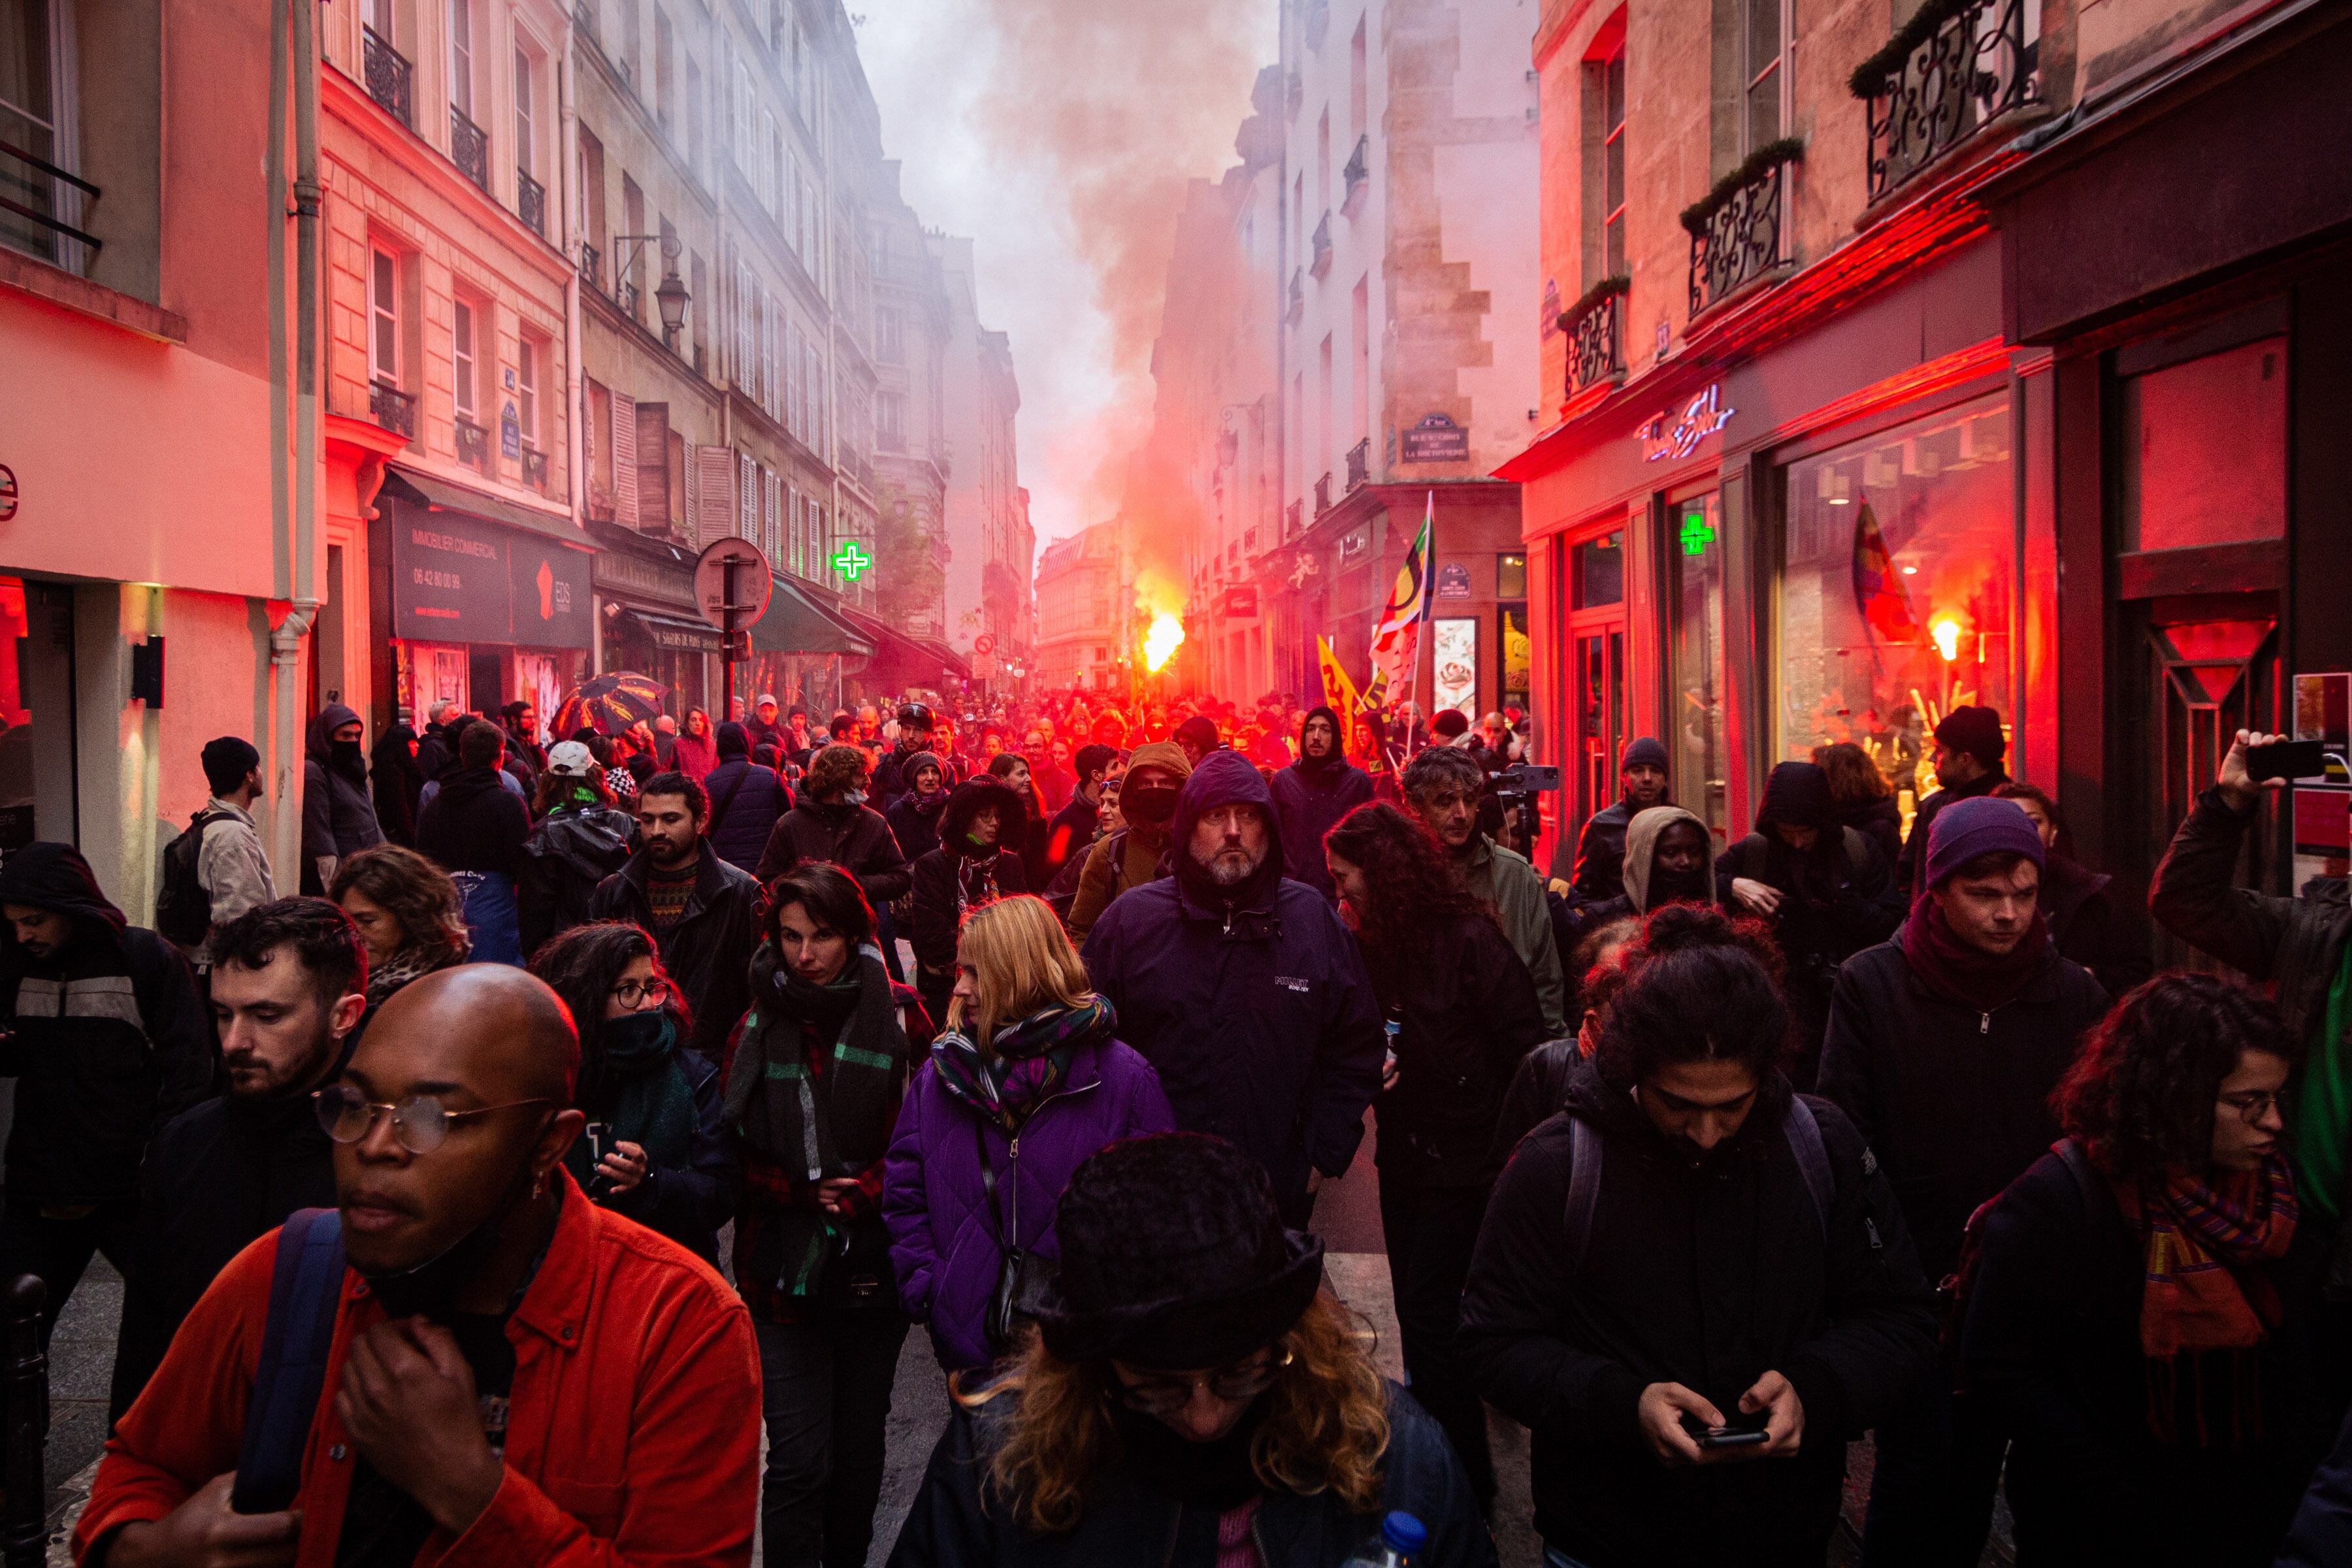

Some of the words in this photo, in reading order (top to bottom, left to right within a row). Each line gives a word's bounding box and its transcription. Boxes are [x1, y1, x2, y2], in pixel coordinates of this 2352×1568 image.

[412, 528, 453, 551] IMMOBILIER
[455, 538, 497, 560] COMMERCIAL
[1275, 976, 1308, 987] MILLET
